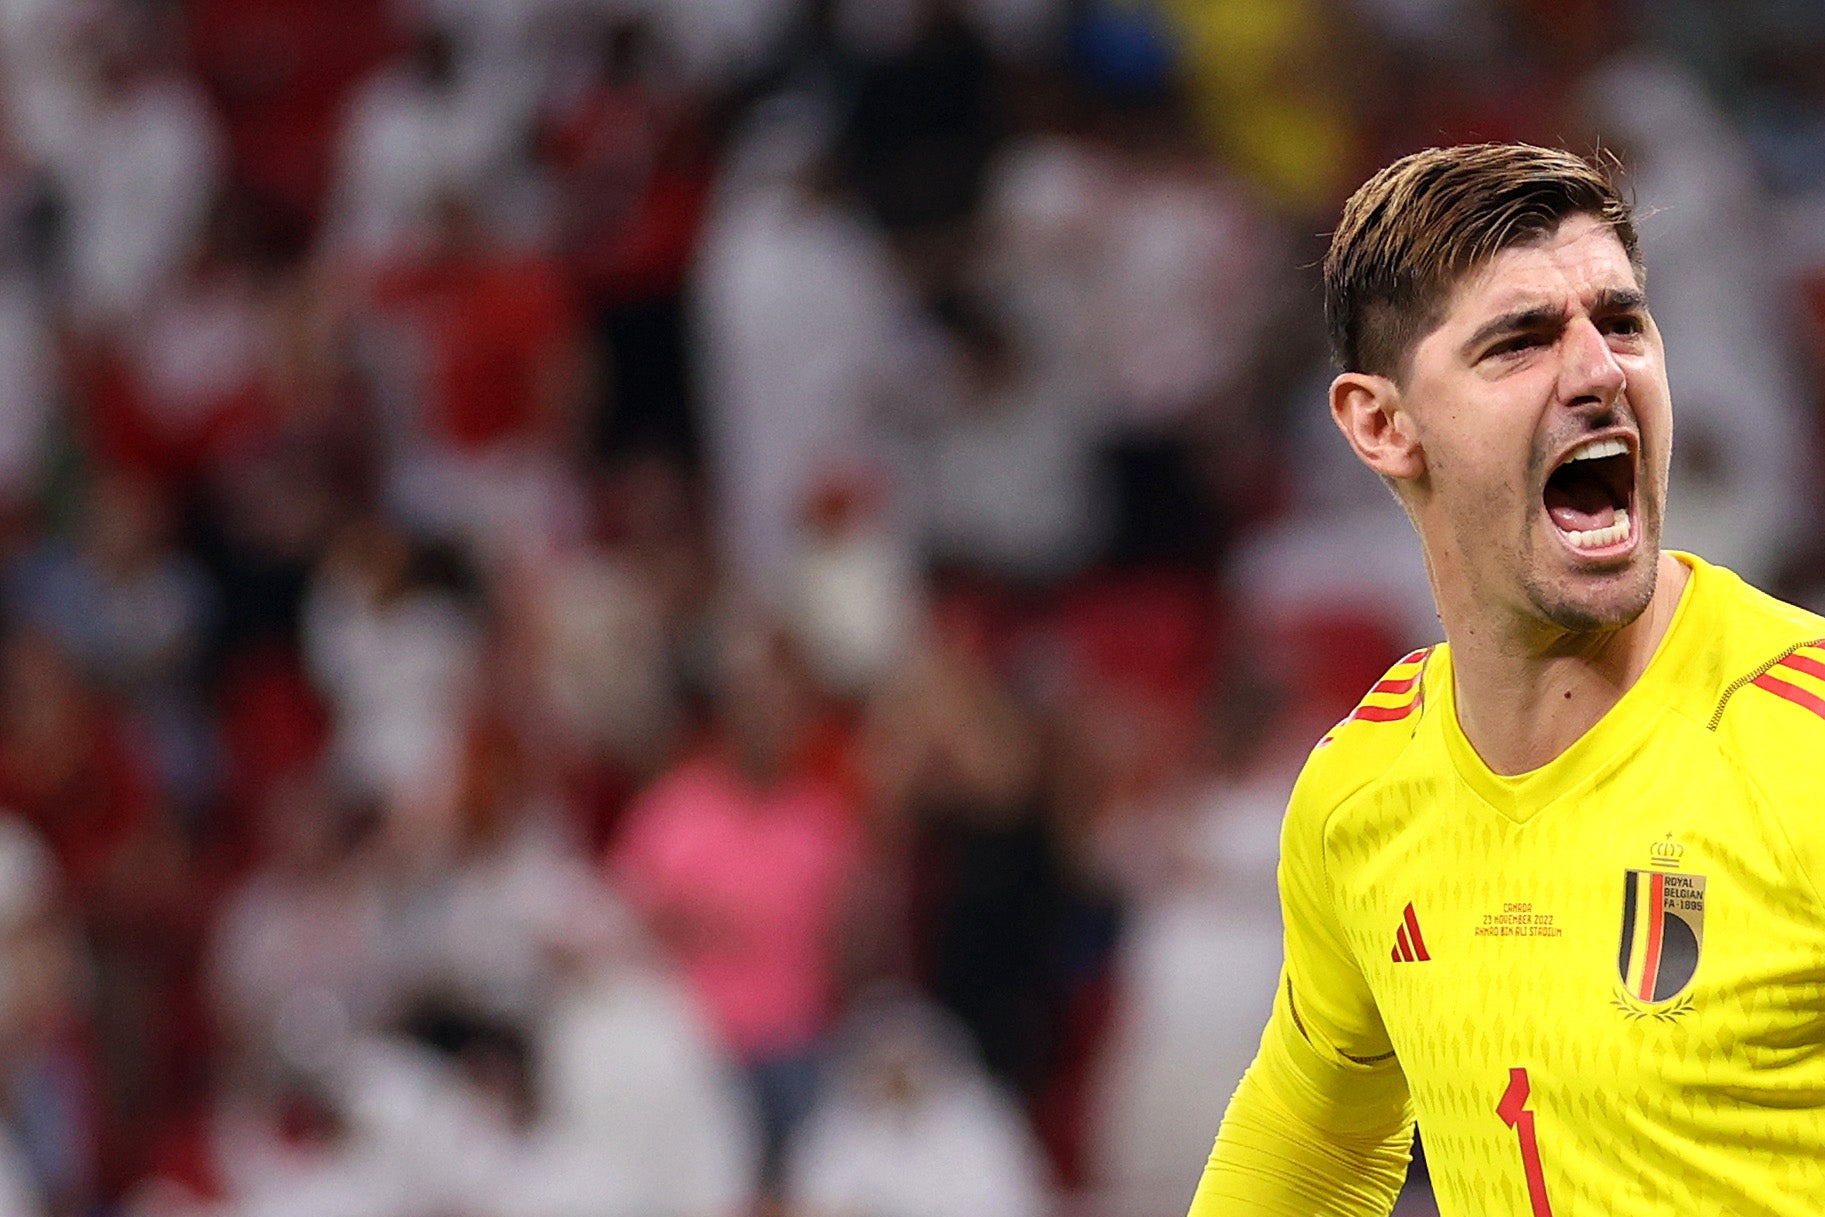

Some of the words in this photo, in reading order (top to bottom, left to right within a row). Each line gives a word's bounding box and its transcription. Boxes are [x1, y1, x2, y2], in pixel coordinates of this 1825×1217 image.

[1664, 876, 1693, 888] ROYAL
[1664, 887, 1704, 900] BELGIAN
[1503, 902, 1532, 913] CANADA
[1483, 914, 1492, 925] 23
[1494, 914, 1532, 925] NOVEMBER
[1534, 914, 1554, 926] 2022
[1500, 926, 1513, 937] BIN
[1514, 926, 1528, 937] ALI
[1529, 926, 1562, 937] STADIUM
